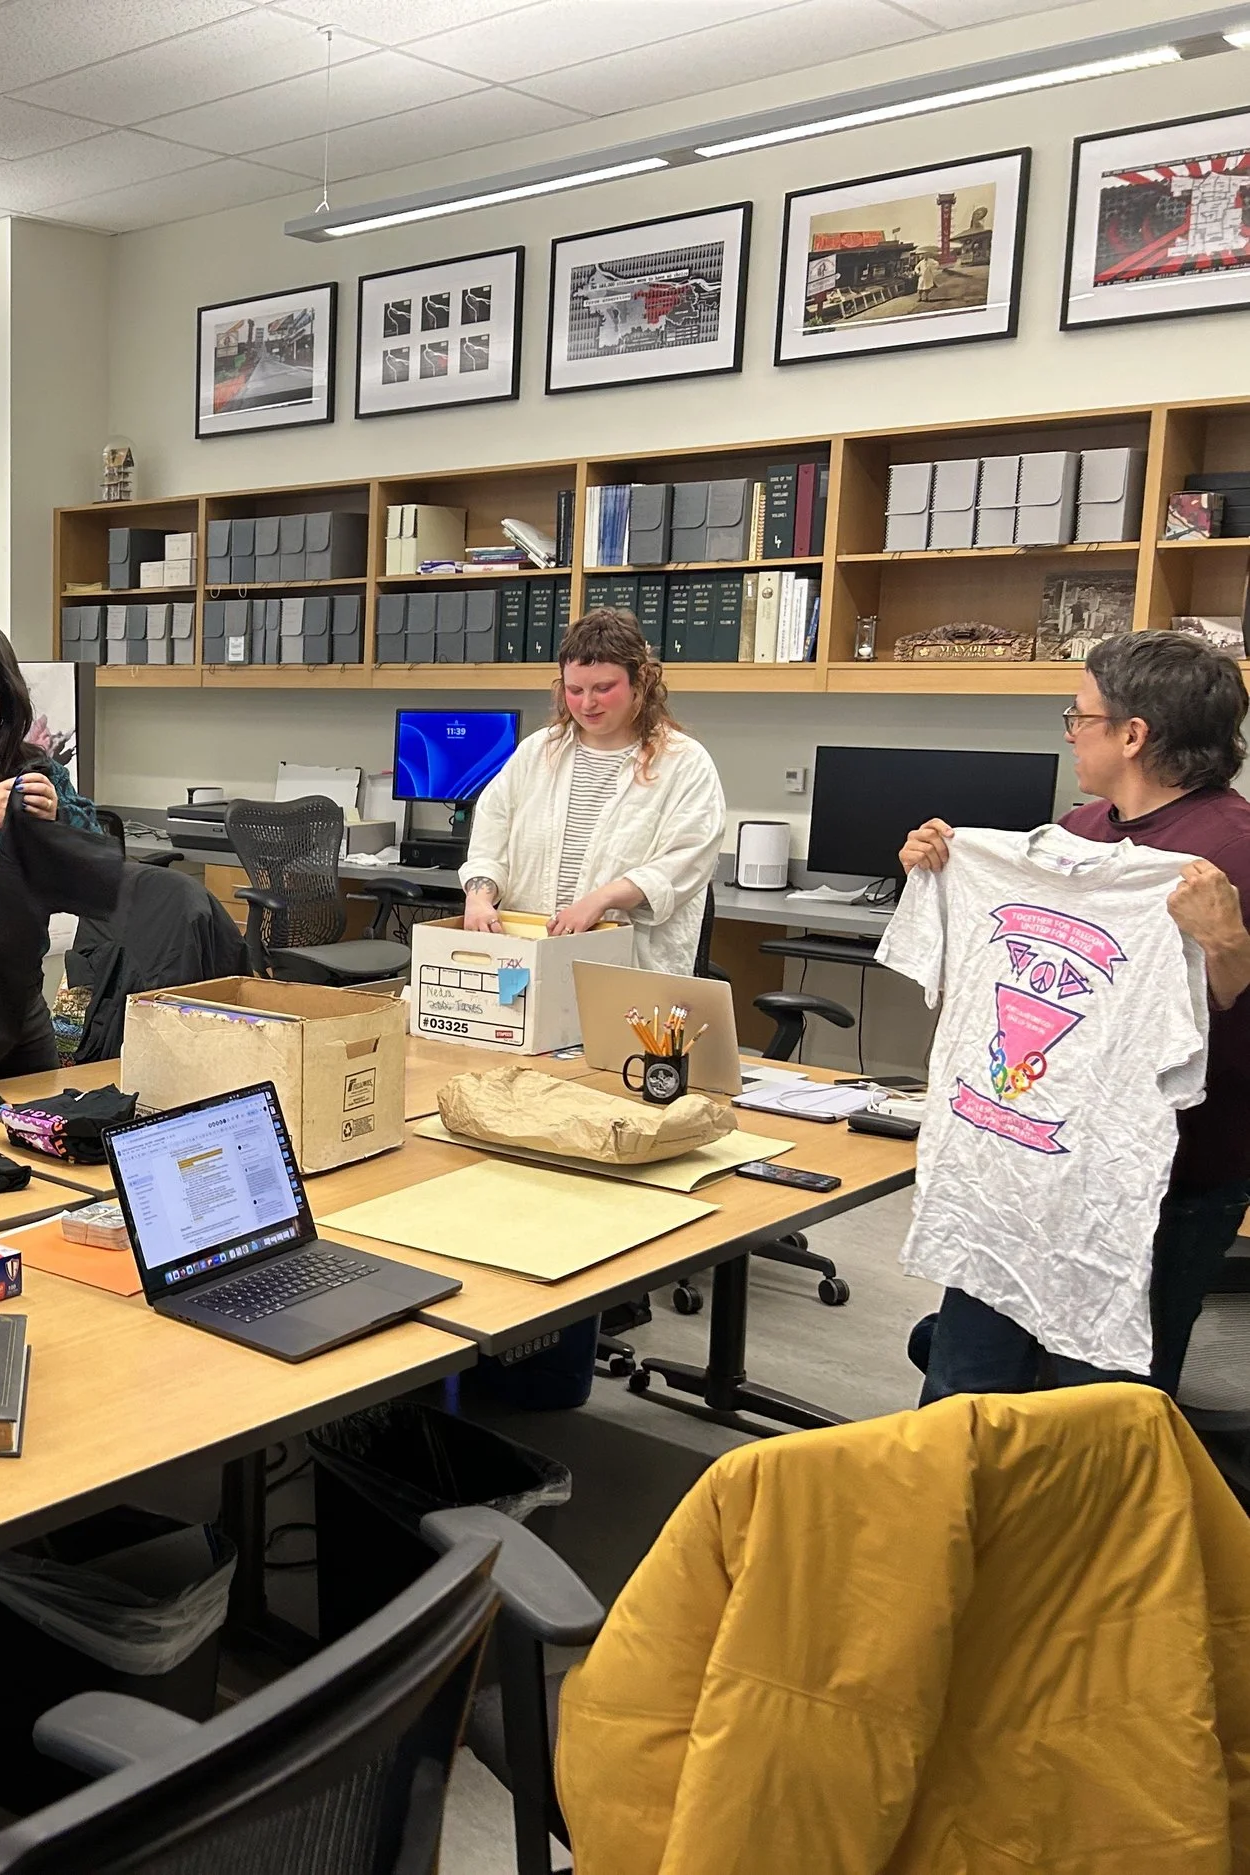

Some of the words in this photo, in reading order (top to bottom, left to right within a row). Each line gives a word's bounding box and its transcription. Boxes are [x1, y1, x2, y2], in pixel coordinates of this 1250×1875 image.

[940, 645, 986, 653] MAYOR
[446, 727, 466, 735] 11:39
[1012, 912, 1054, 925] TOGETHER
[1054, 919, 1071, 931] FOR
[1021, 923, 1050, 935] UNITED
[1051, 930, 1066, 939] FOR
[497, 958, 523, 968] TAX
[423, 1018, 469, 1034] #03325
